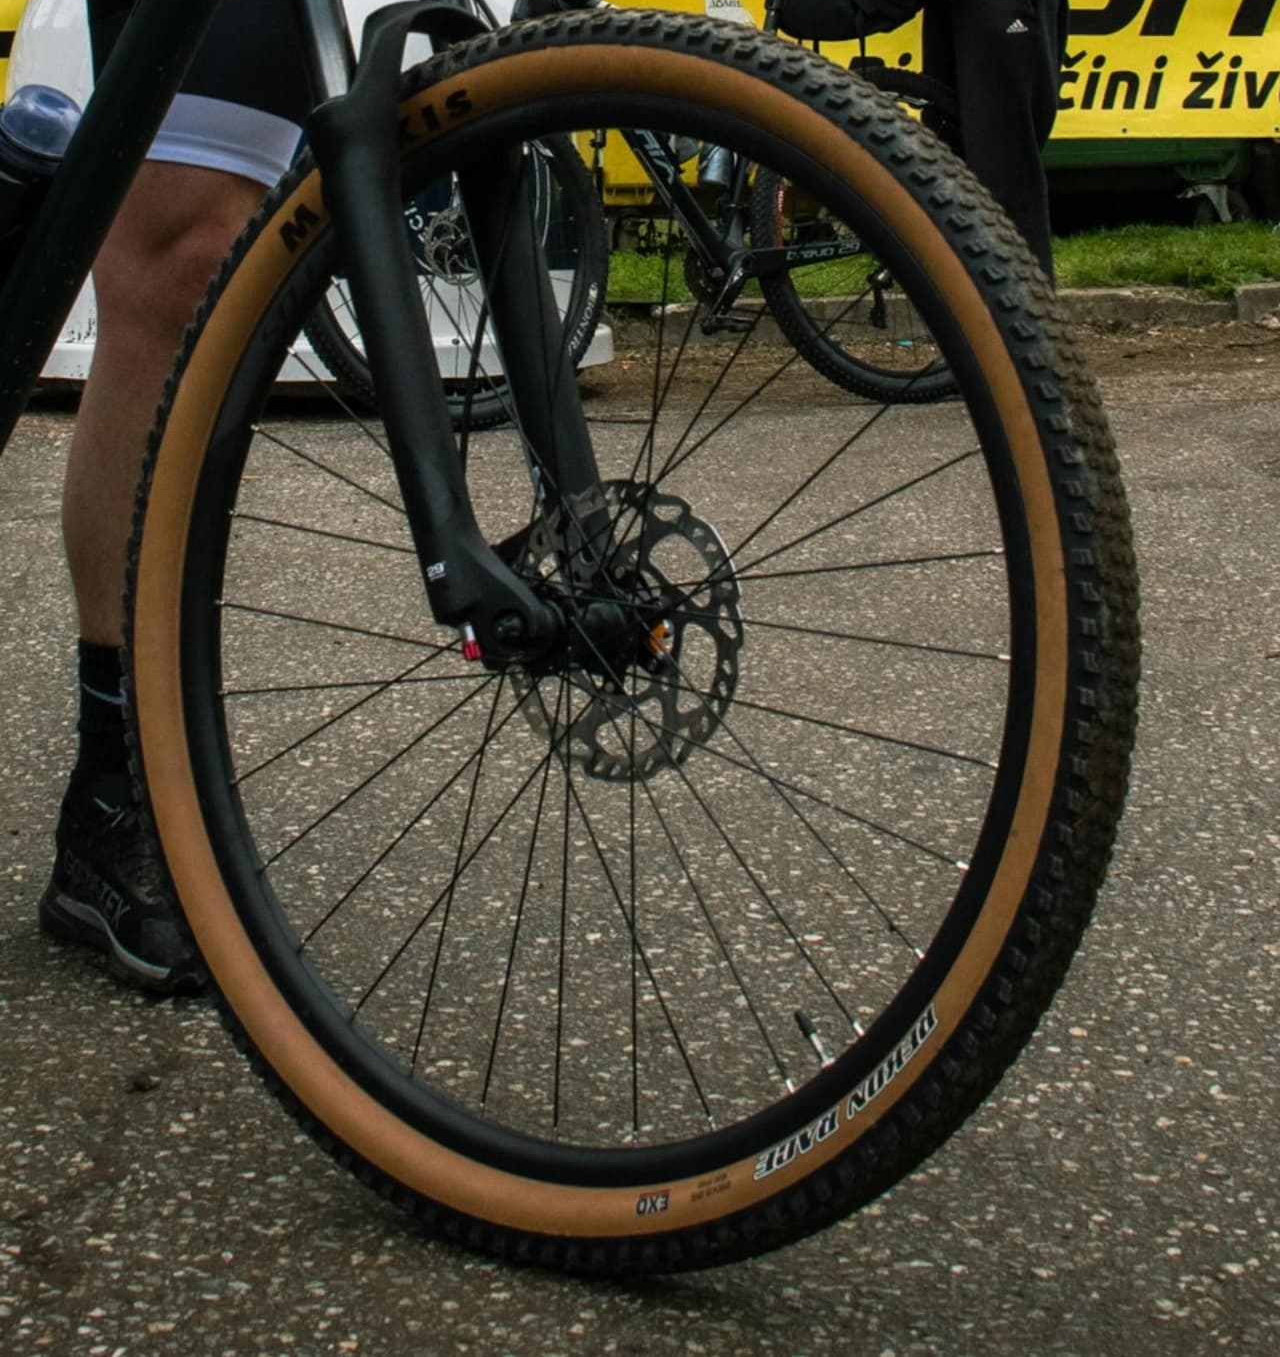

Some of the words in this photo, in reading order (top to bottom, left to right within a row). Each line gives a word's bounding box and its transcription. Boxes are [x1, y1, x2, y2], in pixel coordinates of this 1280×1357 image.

[846, 1002, 938, 1121] REKON
[752, 1105, 840, 1181] RACE
[636, 1192, 670, 1217] EXO
